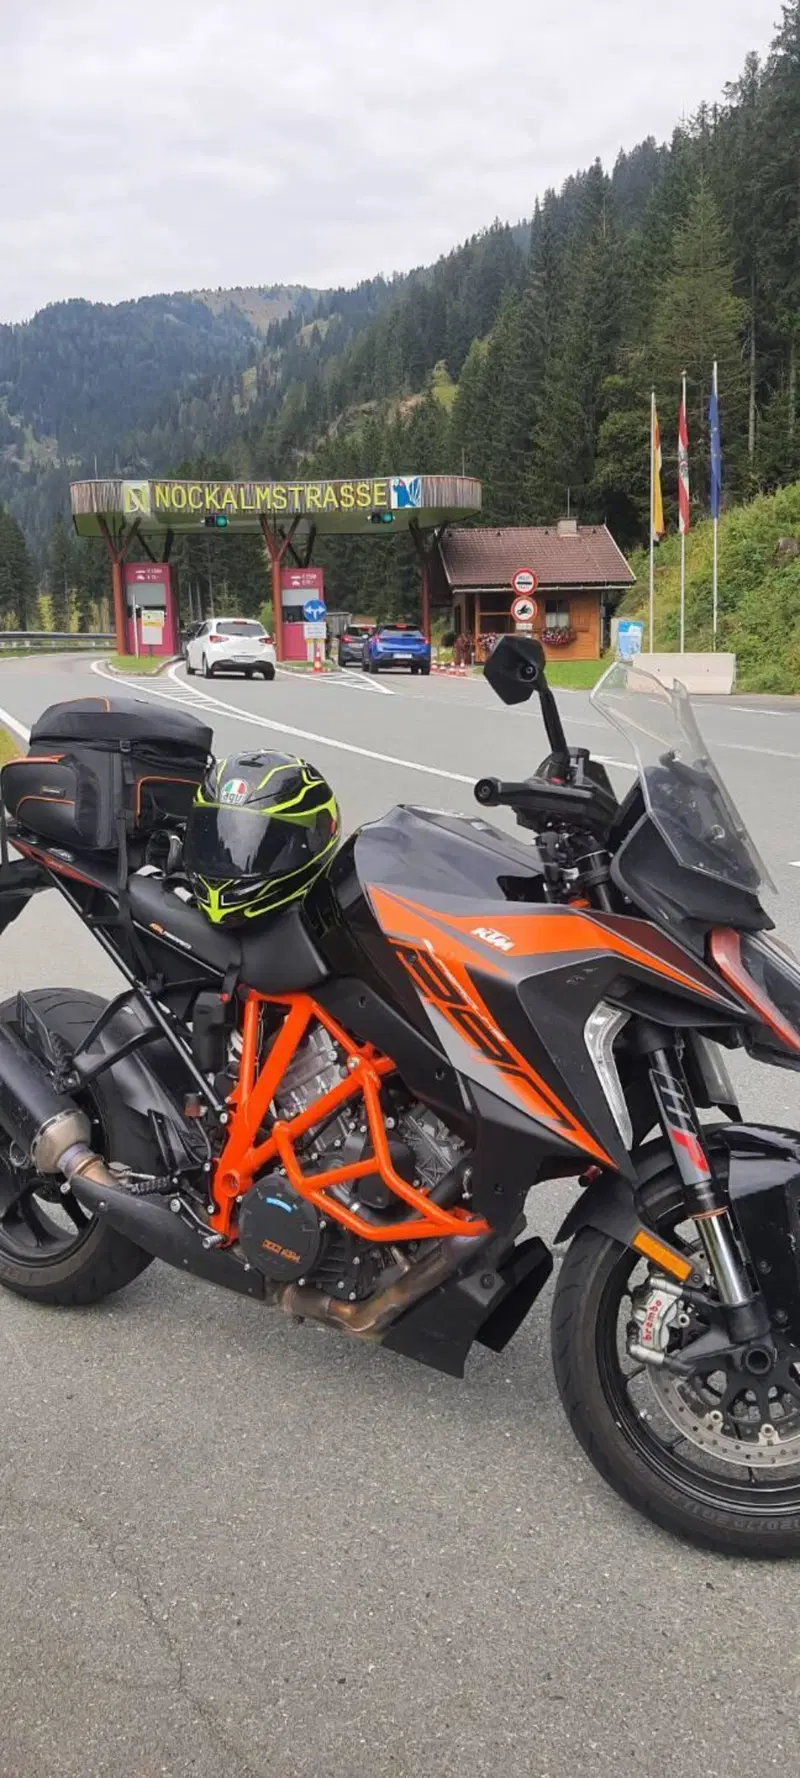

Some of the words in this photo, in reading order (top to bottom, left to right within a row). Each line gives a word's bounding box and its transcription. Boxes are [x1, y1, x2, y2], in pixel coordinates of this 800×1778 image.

[155, 481, 387, 507] NOCKALMSTRASSE
[472, 927, 515, 951] KTM
[643, 1299, 662, 1341] brembo
